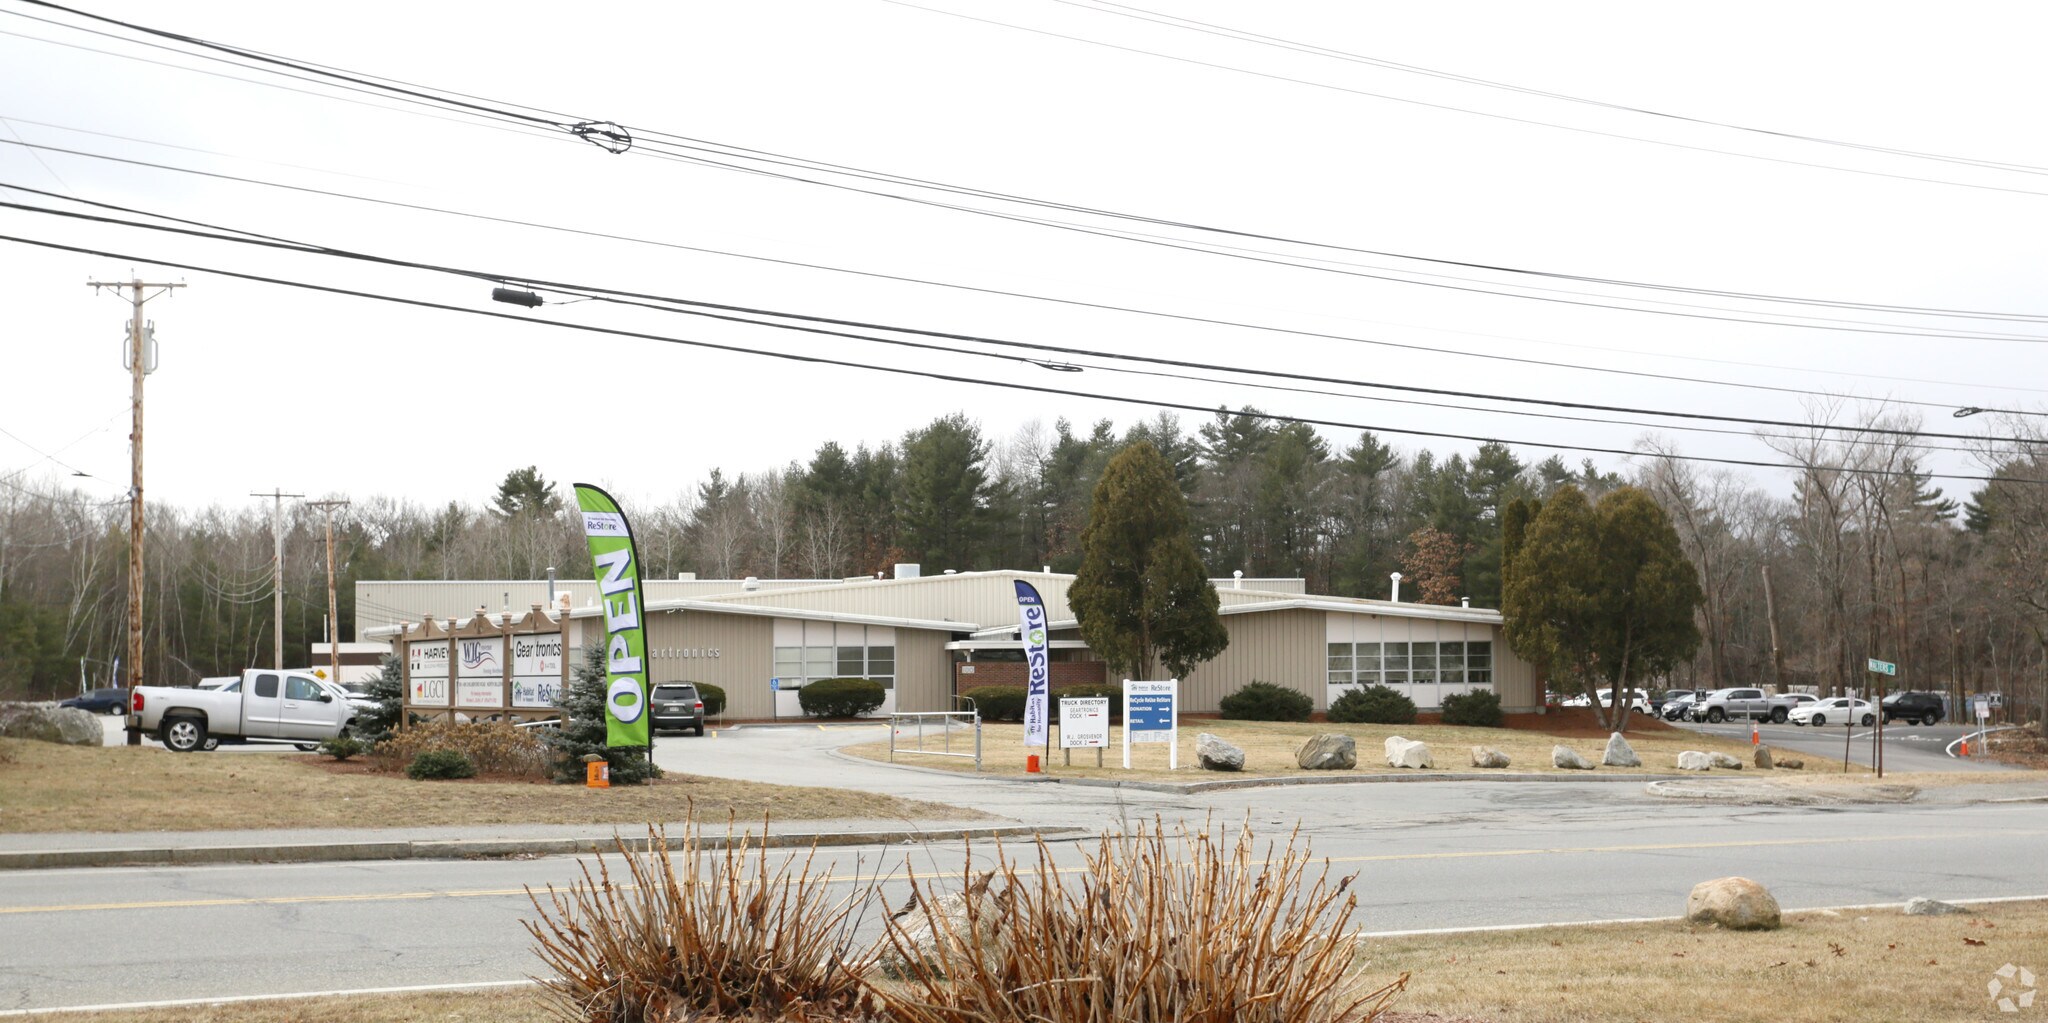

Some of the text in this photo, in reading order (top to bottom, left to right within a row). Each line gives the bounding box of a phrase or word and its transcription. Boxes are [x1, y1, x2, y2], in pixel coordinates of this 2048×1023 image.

[587, 521, 617, 531] ReStore
[594, 548, 644, 724] OPEN
[424, 647, 449, 659] HARVEY
[516, 639, 562, 658] Gear tronics
[652, 646, 720, 659] artronics
[1026, 606, 1045, 696] ReStore
[424, 680, 444, 698] LGCI
